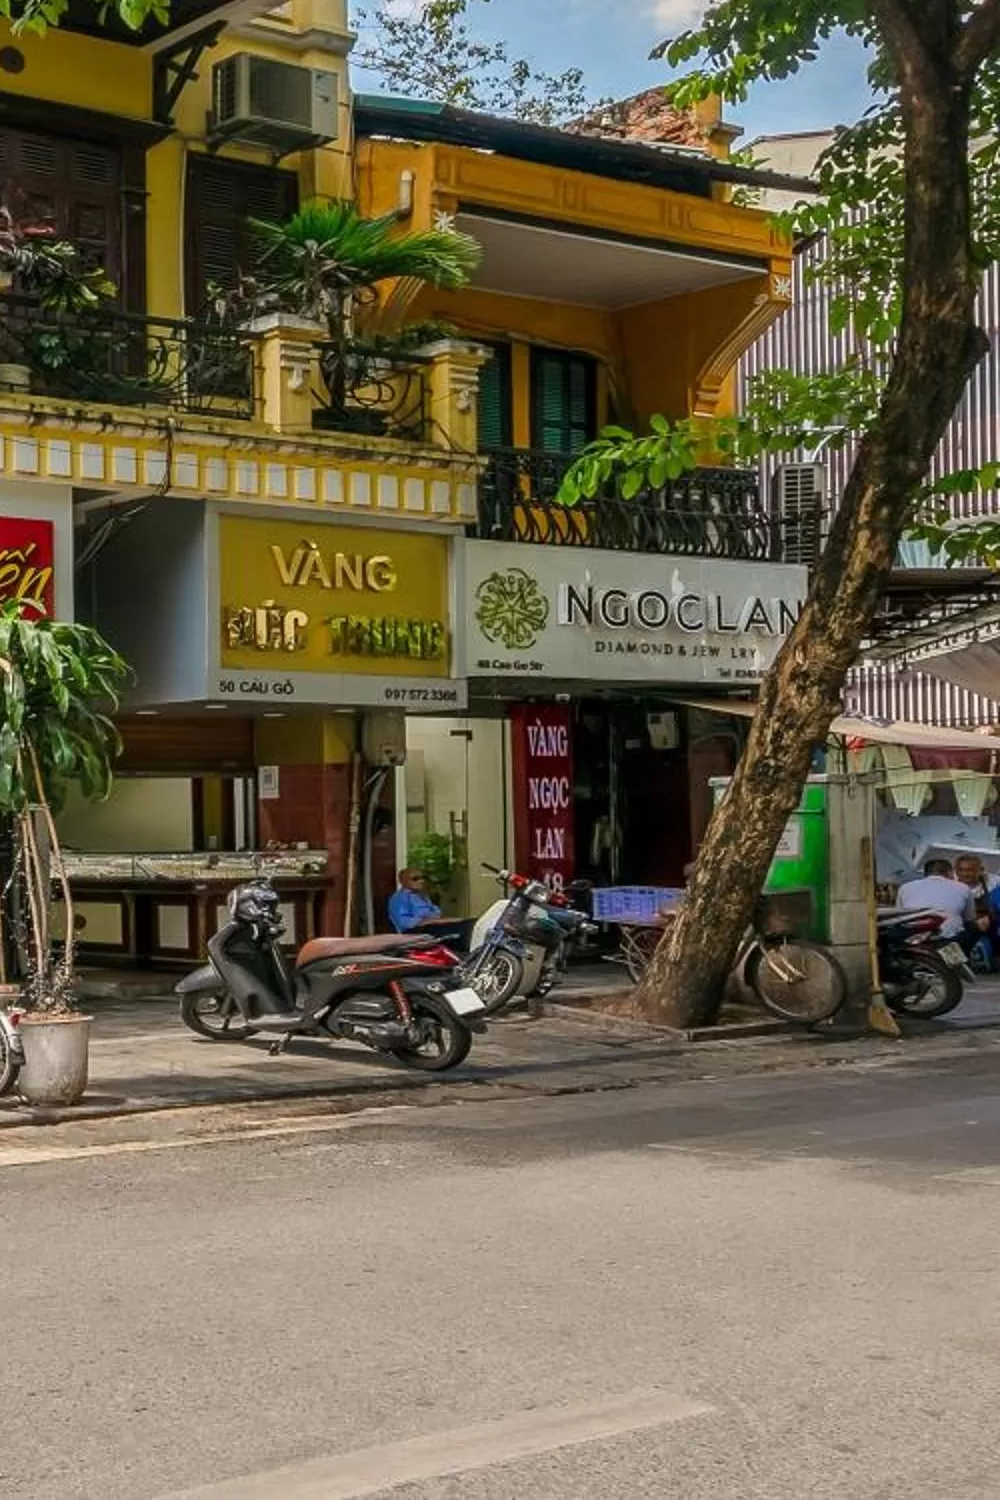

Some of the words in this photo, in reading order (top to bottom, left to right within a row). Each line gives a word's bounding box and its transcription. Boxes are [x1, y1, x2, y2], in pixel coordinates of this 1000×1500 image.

[271, 539, 398, 592] VÀNG
[595, 640, 674, 656] DIAMOND
[527, 718, 568, 757] VÀNG
[528, 776, 569, 815] NGỌC
[535, 827, 565, 860] LAN
